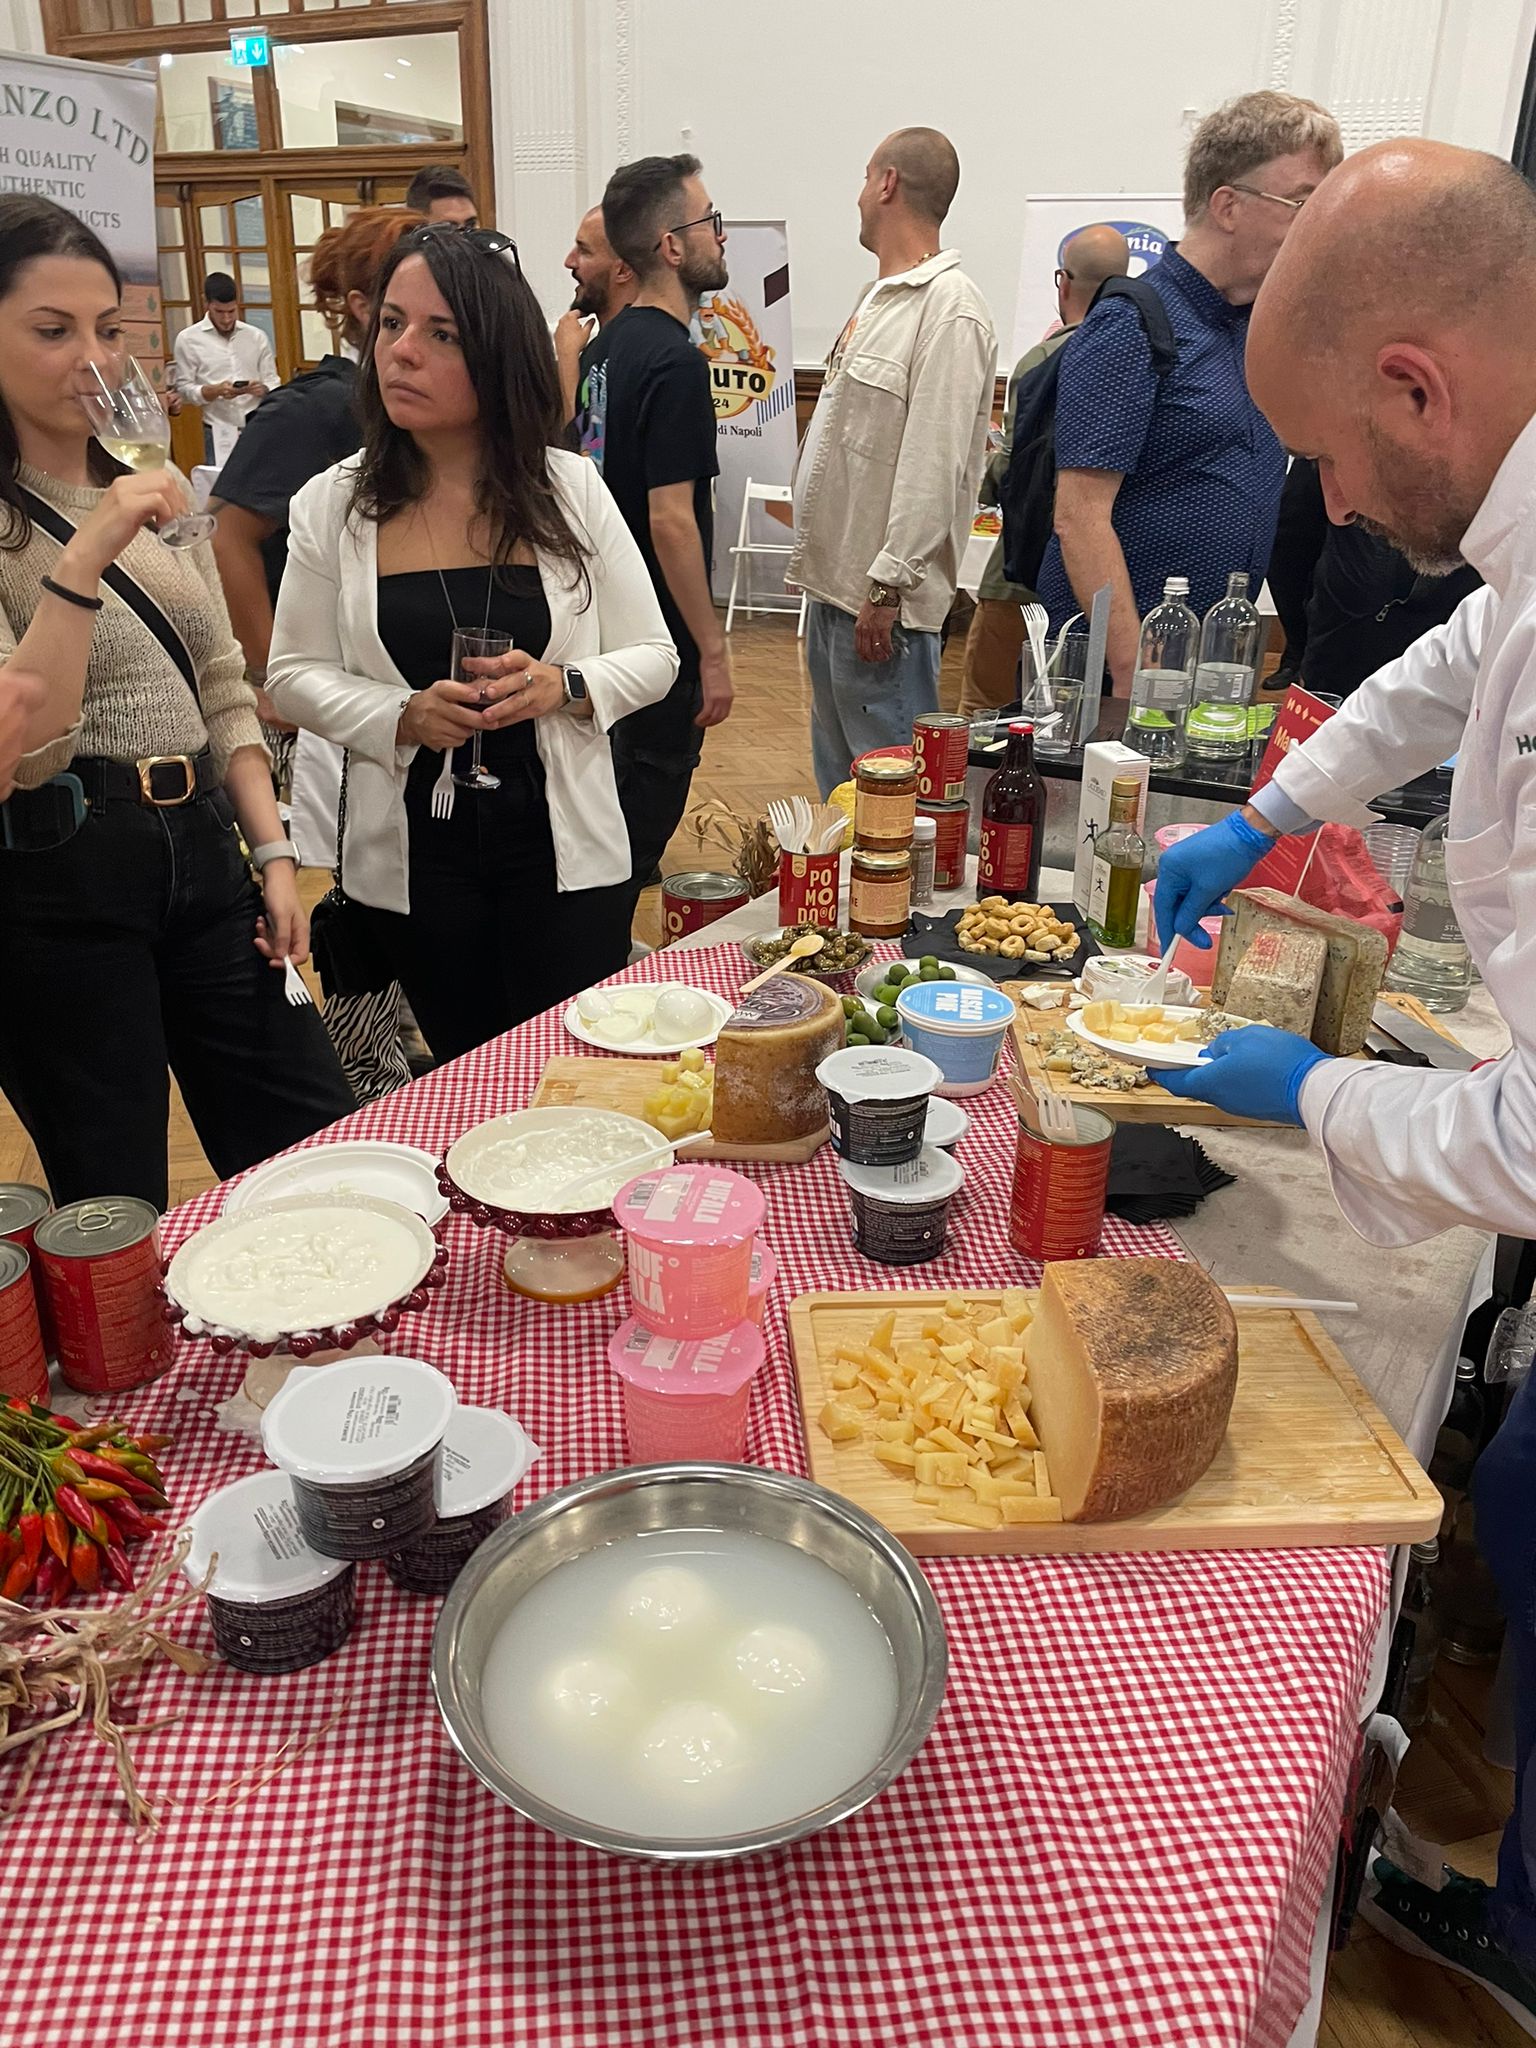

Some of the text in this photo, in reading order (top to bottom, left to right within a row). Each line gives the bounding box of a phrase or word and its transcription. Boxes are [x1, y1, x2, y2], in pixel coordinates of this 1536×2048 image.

[0, 83, 150, 166] NZO LTD
[15, 148, 97, 172] QUALITY
[1126, 233, 1163, 255] nia
[713, 367, 766, 393] UTO
[717, 425, 762, 438] di Napoli
[1273, 725, 1291, 754] Ma
[810, 868, 832, 888] PO
[805, 887, 834, 907] MO
[691, 1332, 732, 1374] UFALA
